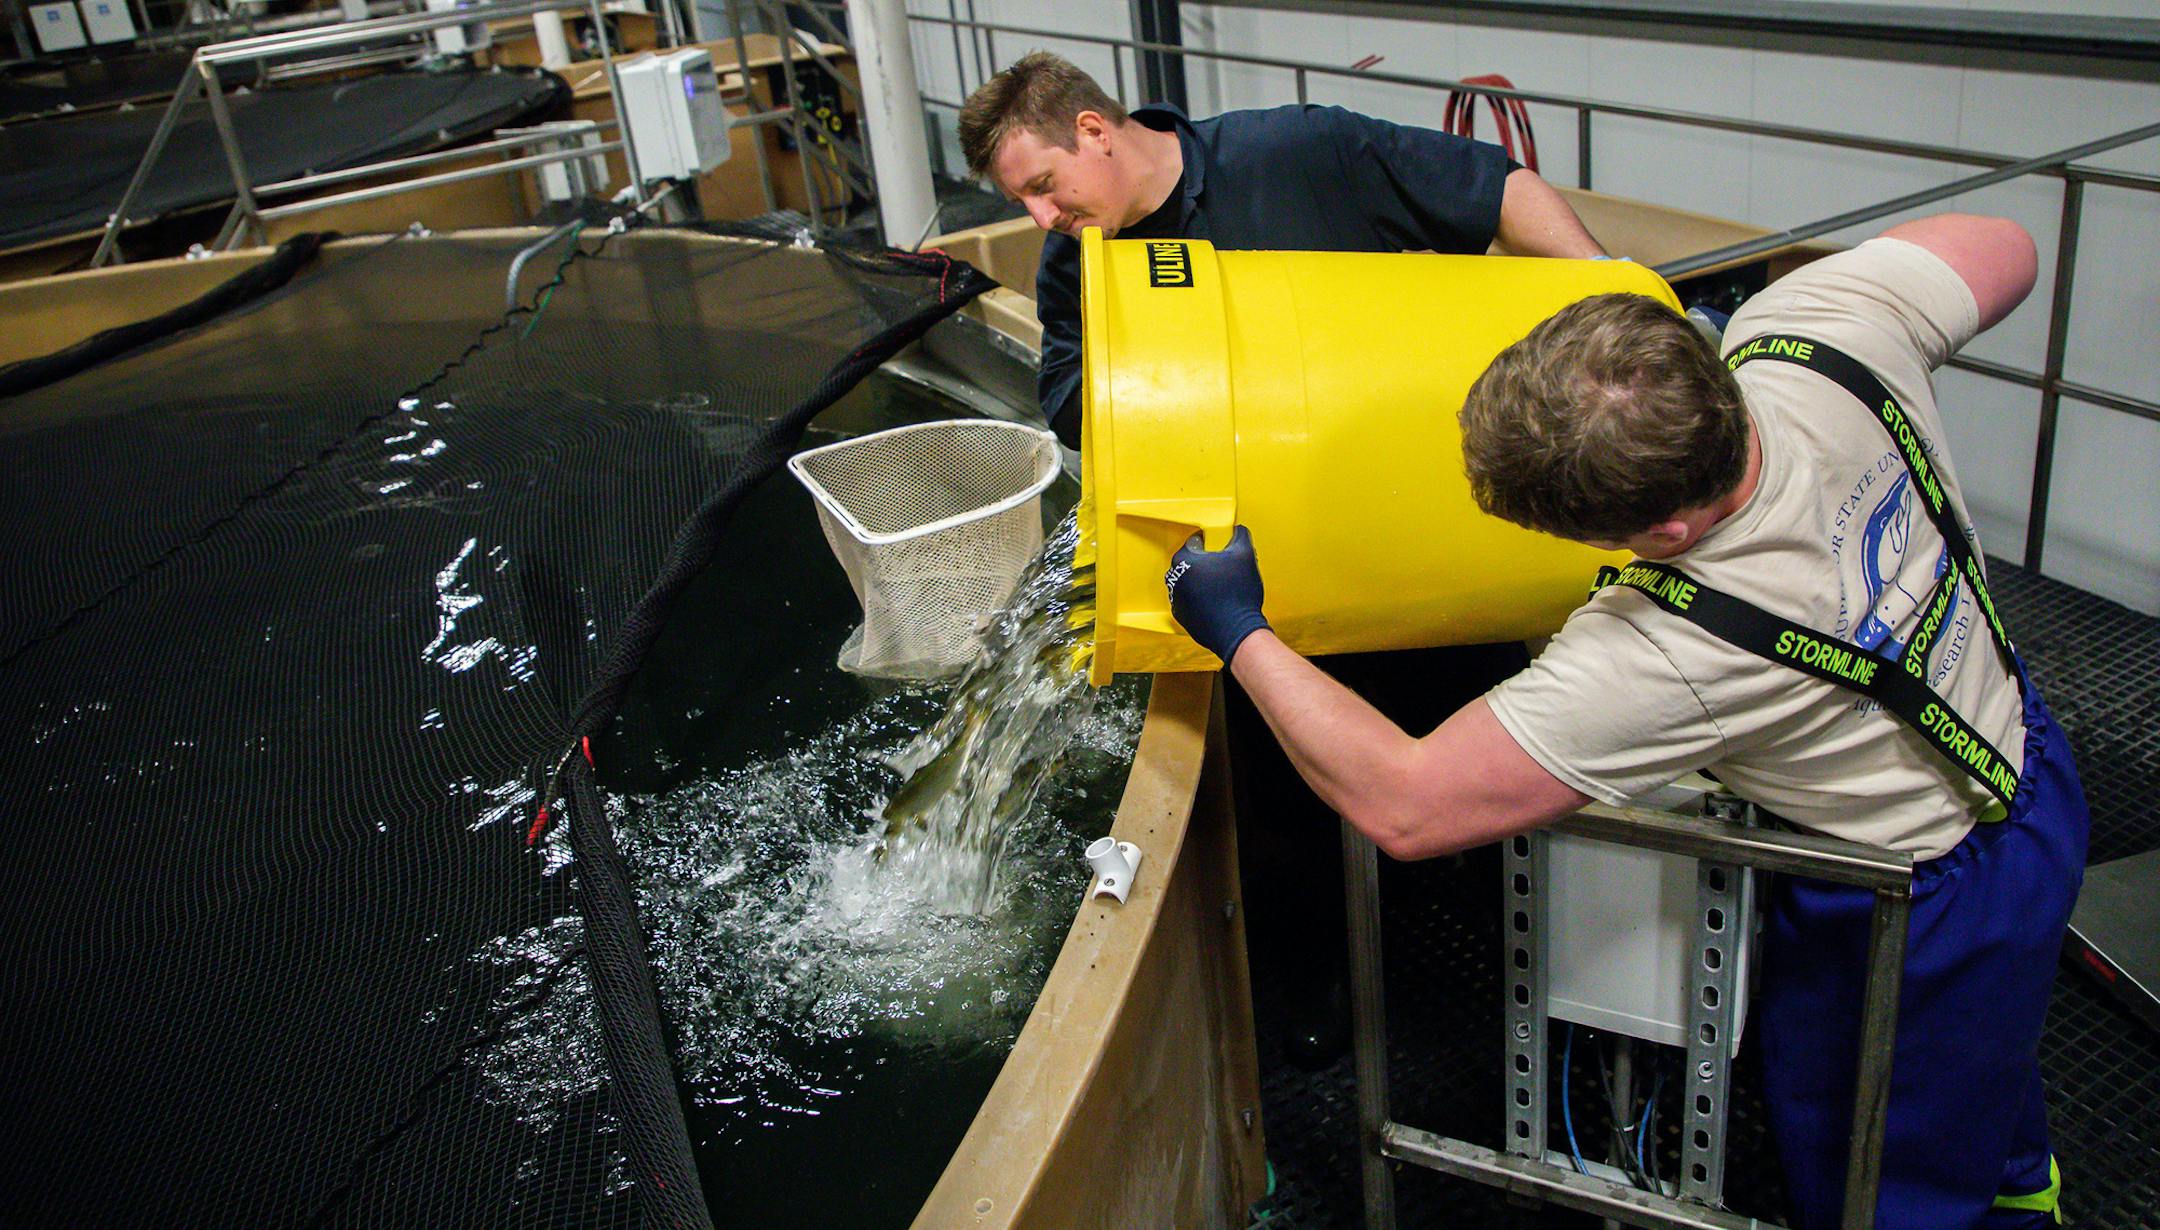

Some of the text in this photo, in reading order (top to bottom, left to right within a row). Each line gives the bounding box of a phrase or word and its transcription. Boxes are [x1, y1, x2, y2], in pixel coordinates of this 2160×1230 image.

[1153, 243, 1186, 283] ULINE
[1728, 338, 1814, 371] RMLINE
[1882, 400, 1944, 514] STORMLINE
[1835, 469, 1876, 531] STATE
[1905, 555, 1959, 679] STORMLINE
[1775, 630, 1878, 686] STORMLINE
[1920, 703, 2018, 801] STORMLINE
